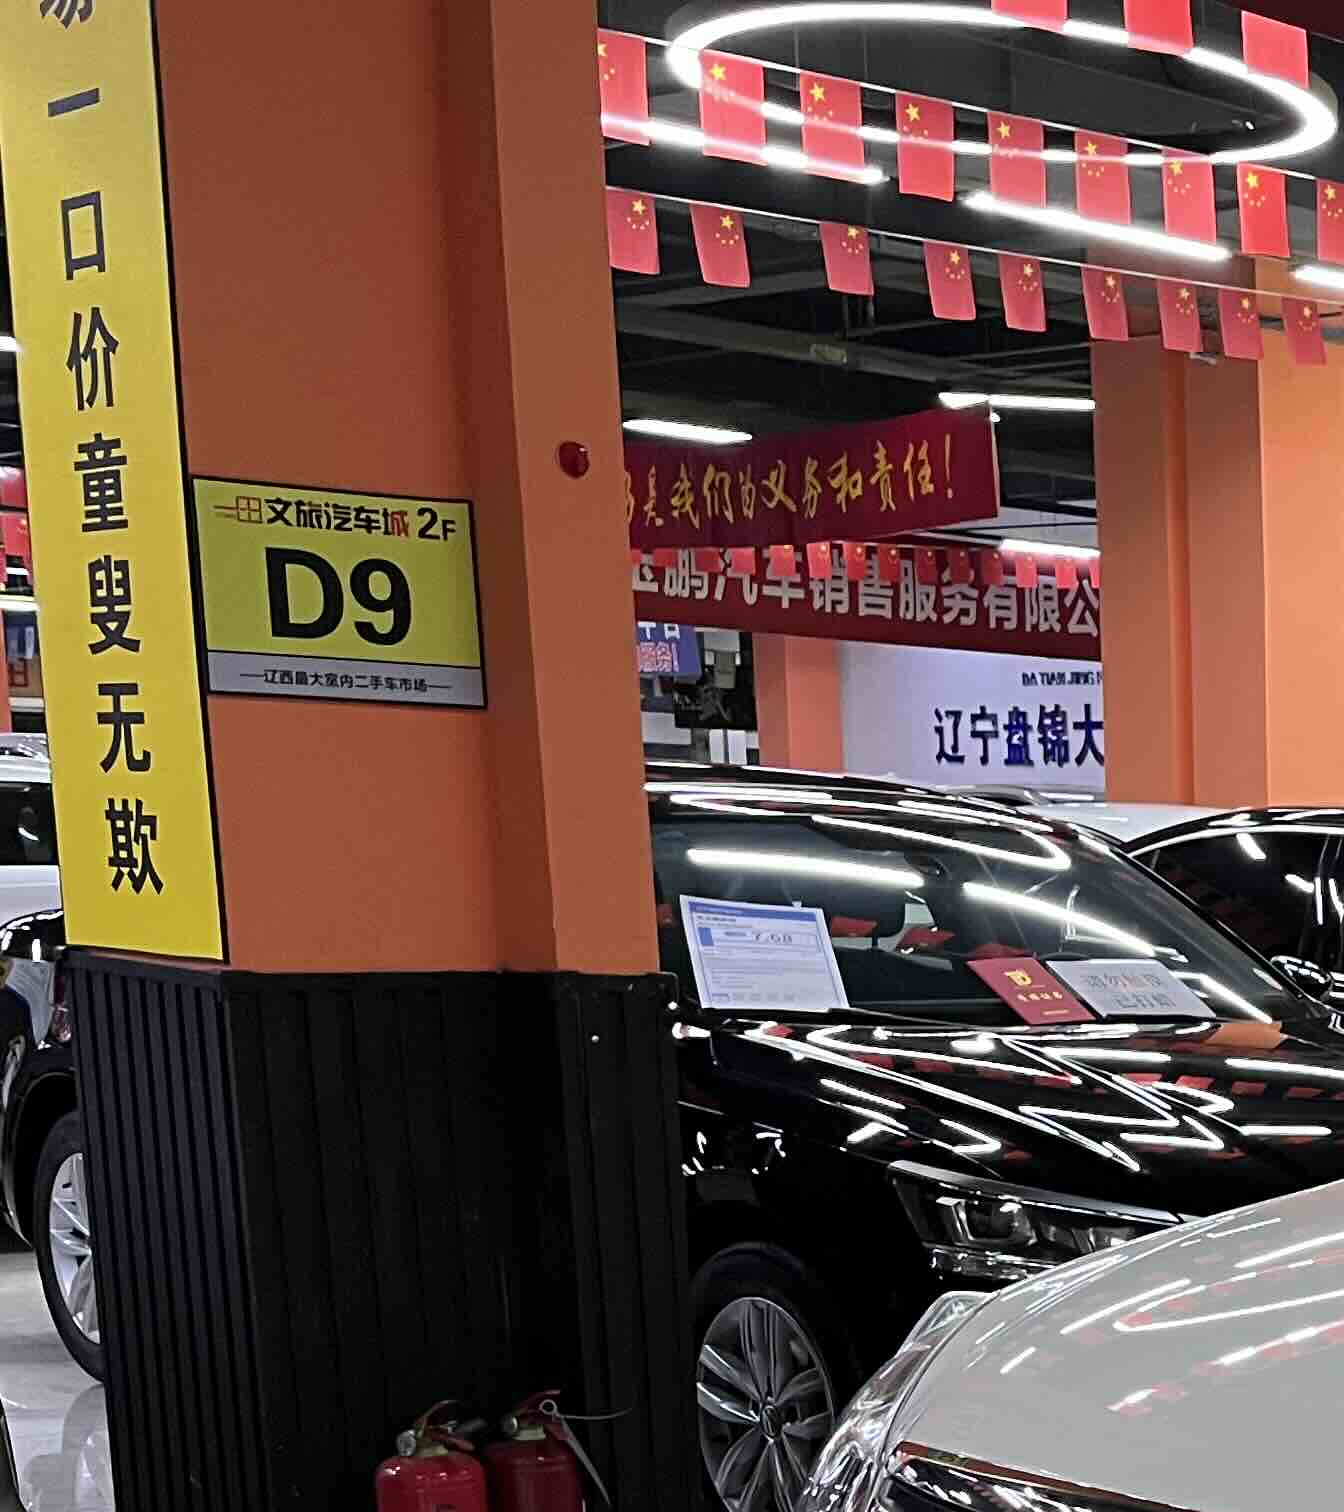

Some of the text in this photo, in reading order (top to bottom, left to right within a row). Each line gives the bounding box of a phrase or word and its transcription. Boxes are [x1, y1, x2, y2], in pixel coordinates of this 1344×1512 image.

[264, 497, 457, 542] 文旅汽车城 2F
[265, 546, 412, 647] D9
[934, 703, 1104, 768] 辽宁盘锦大
